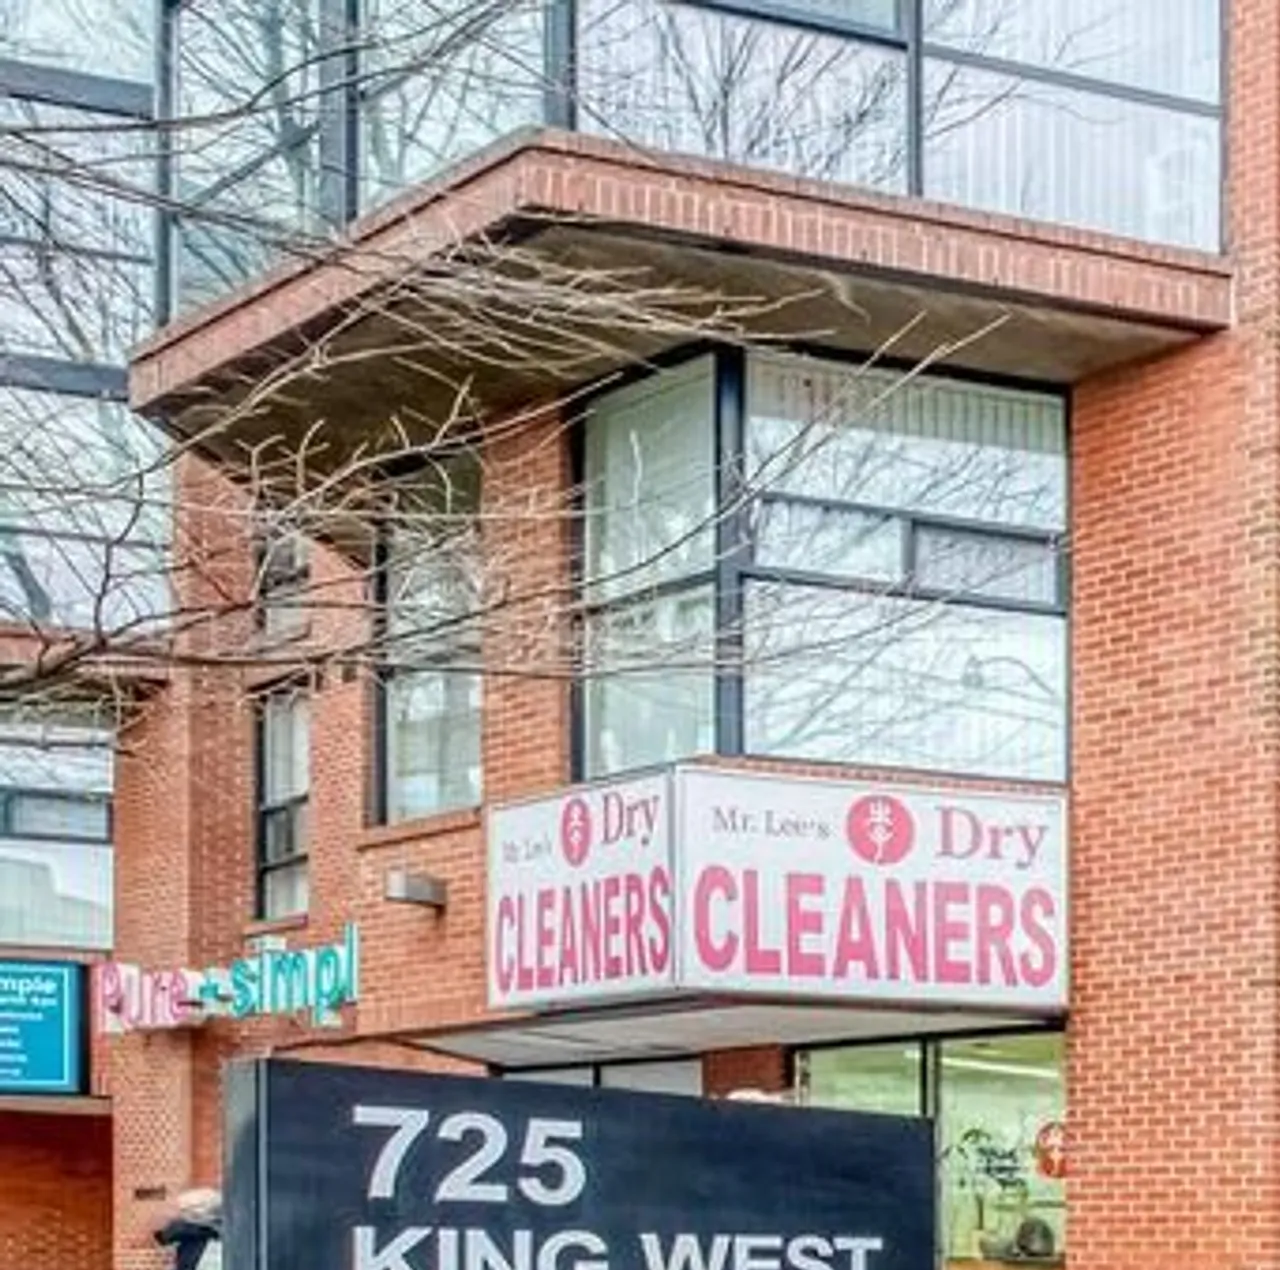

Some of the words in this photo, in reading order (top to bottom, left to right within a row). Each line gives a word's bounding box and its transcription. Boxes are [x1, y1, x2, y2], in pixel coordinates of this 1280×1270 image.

[601, 792, 660, 845] Dry
[711, 805, 759, 834] Mr.
[934, 806, 1050, 868] Dry
[495, 864, 671, 993] CLEANERS
[693, 865, 1056, 988] CLEANERS
[352, 1105, 587, 1206] 725
